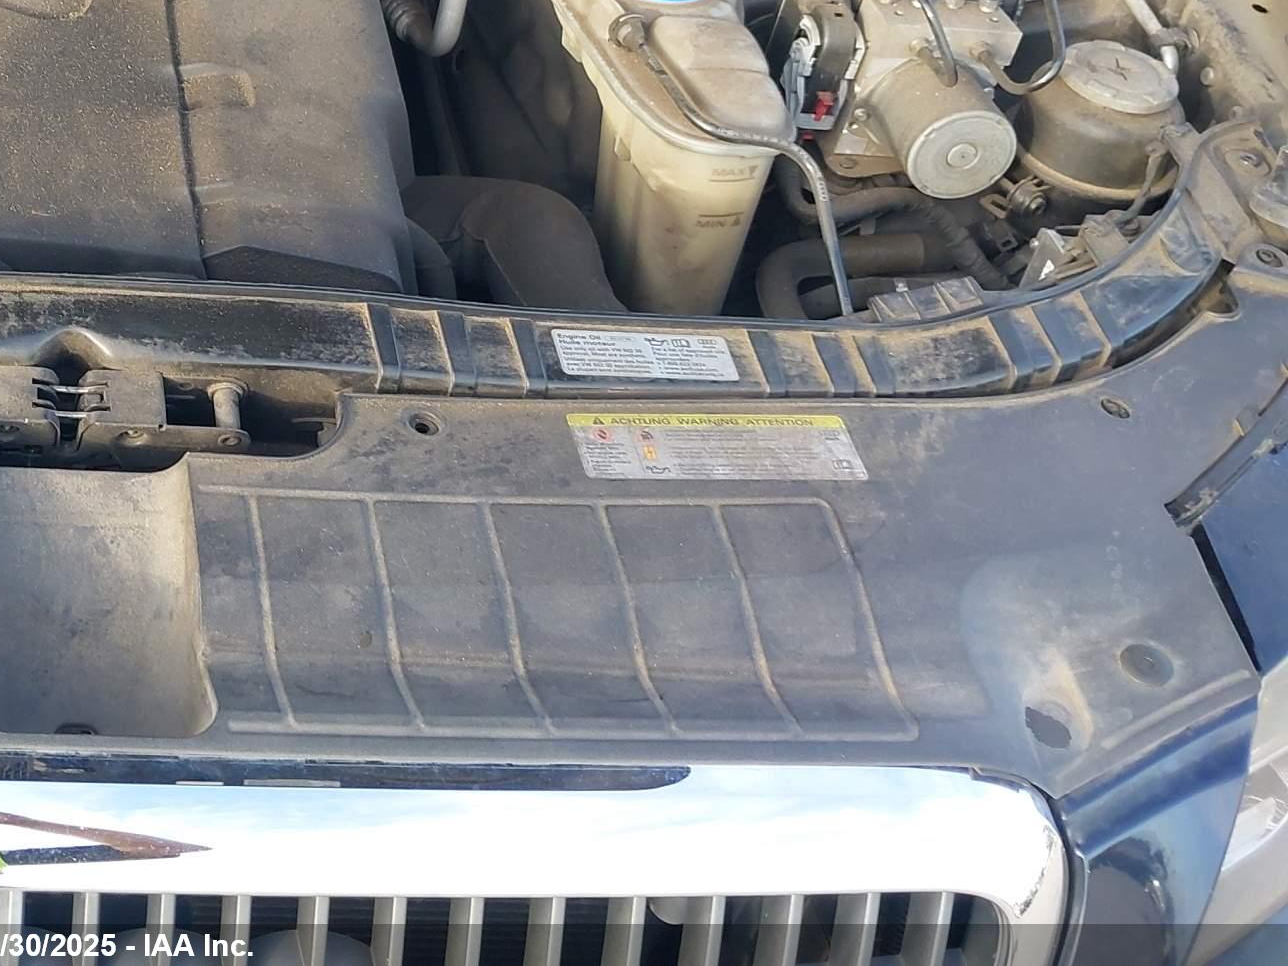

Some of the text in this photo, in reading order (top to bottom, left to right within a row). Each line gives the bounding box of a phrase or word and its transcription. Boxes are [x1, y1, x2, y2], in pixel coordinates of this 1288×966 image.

[611, 417, 814, 426] ACHTUNG WARNING ATTENTION
